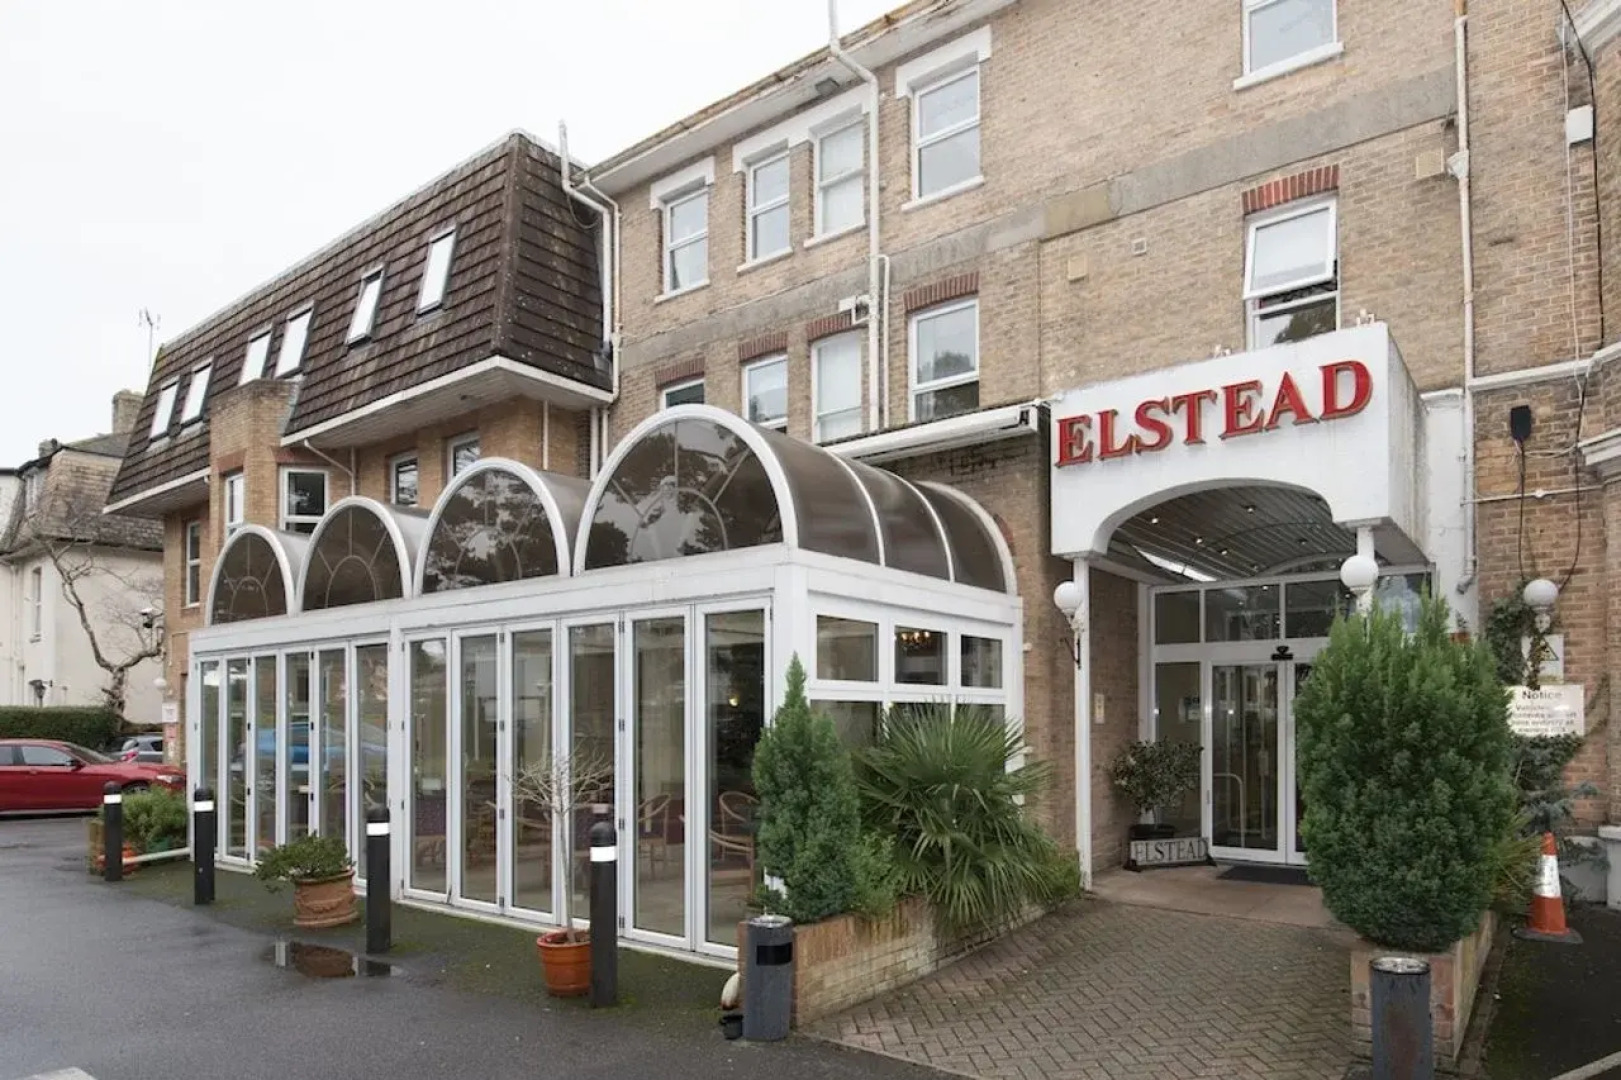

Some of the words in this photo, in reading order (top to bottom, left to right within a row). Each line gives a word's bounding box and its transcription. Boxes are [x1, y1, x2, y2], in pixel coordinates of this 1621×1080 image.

[1055, 360, 1374, 467] ELSTEAD
[1522, 690, 1562, 700] Notice
[1134, 839, 1209, 862] ELSTEAD
